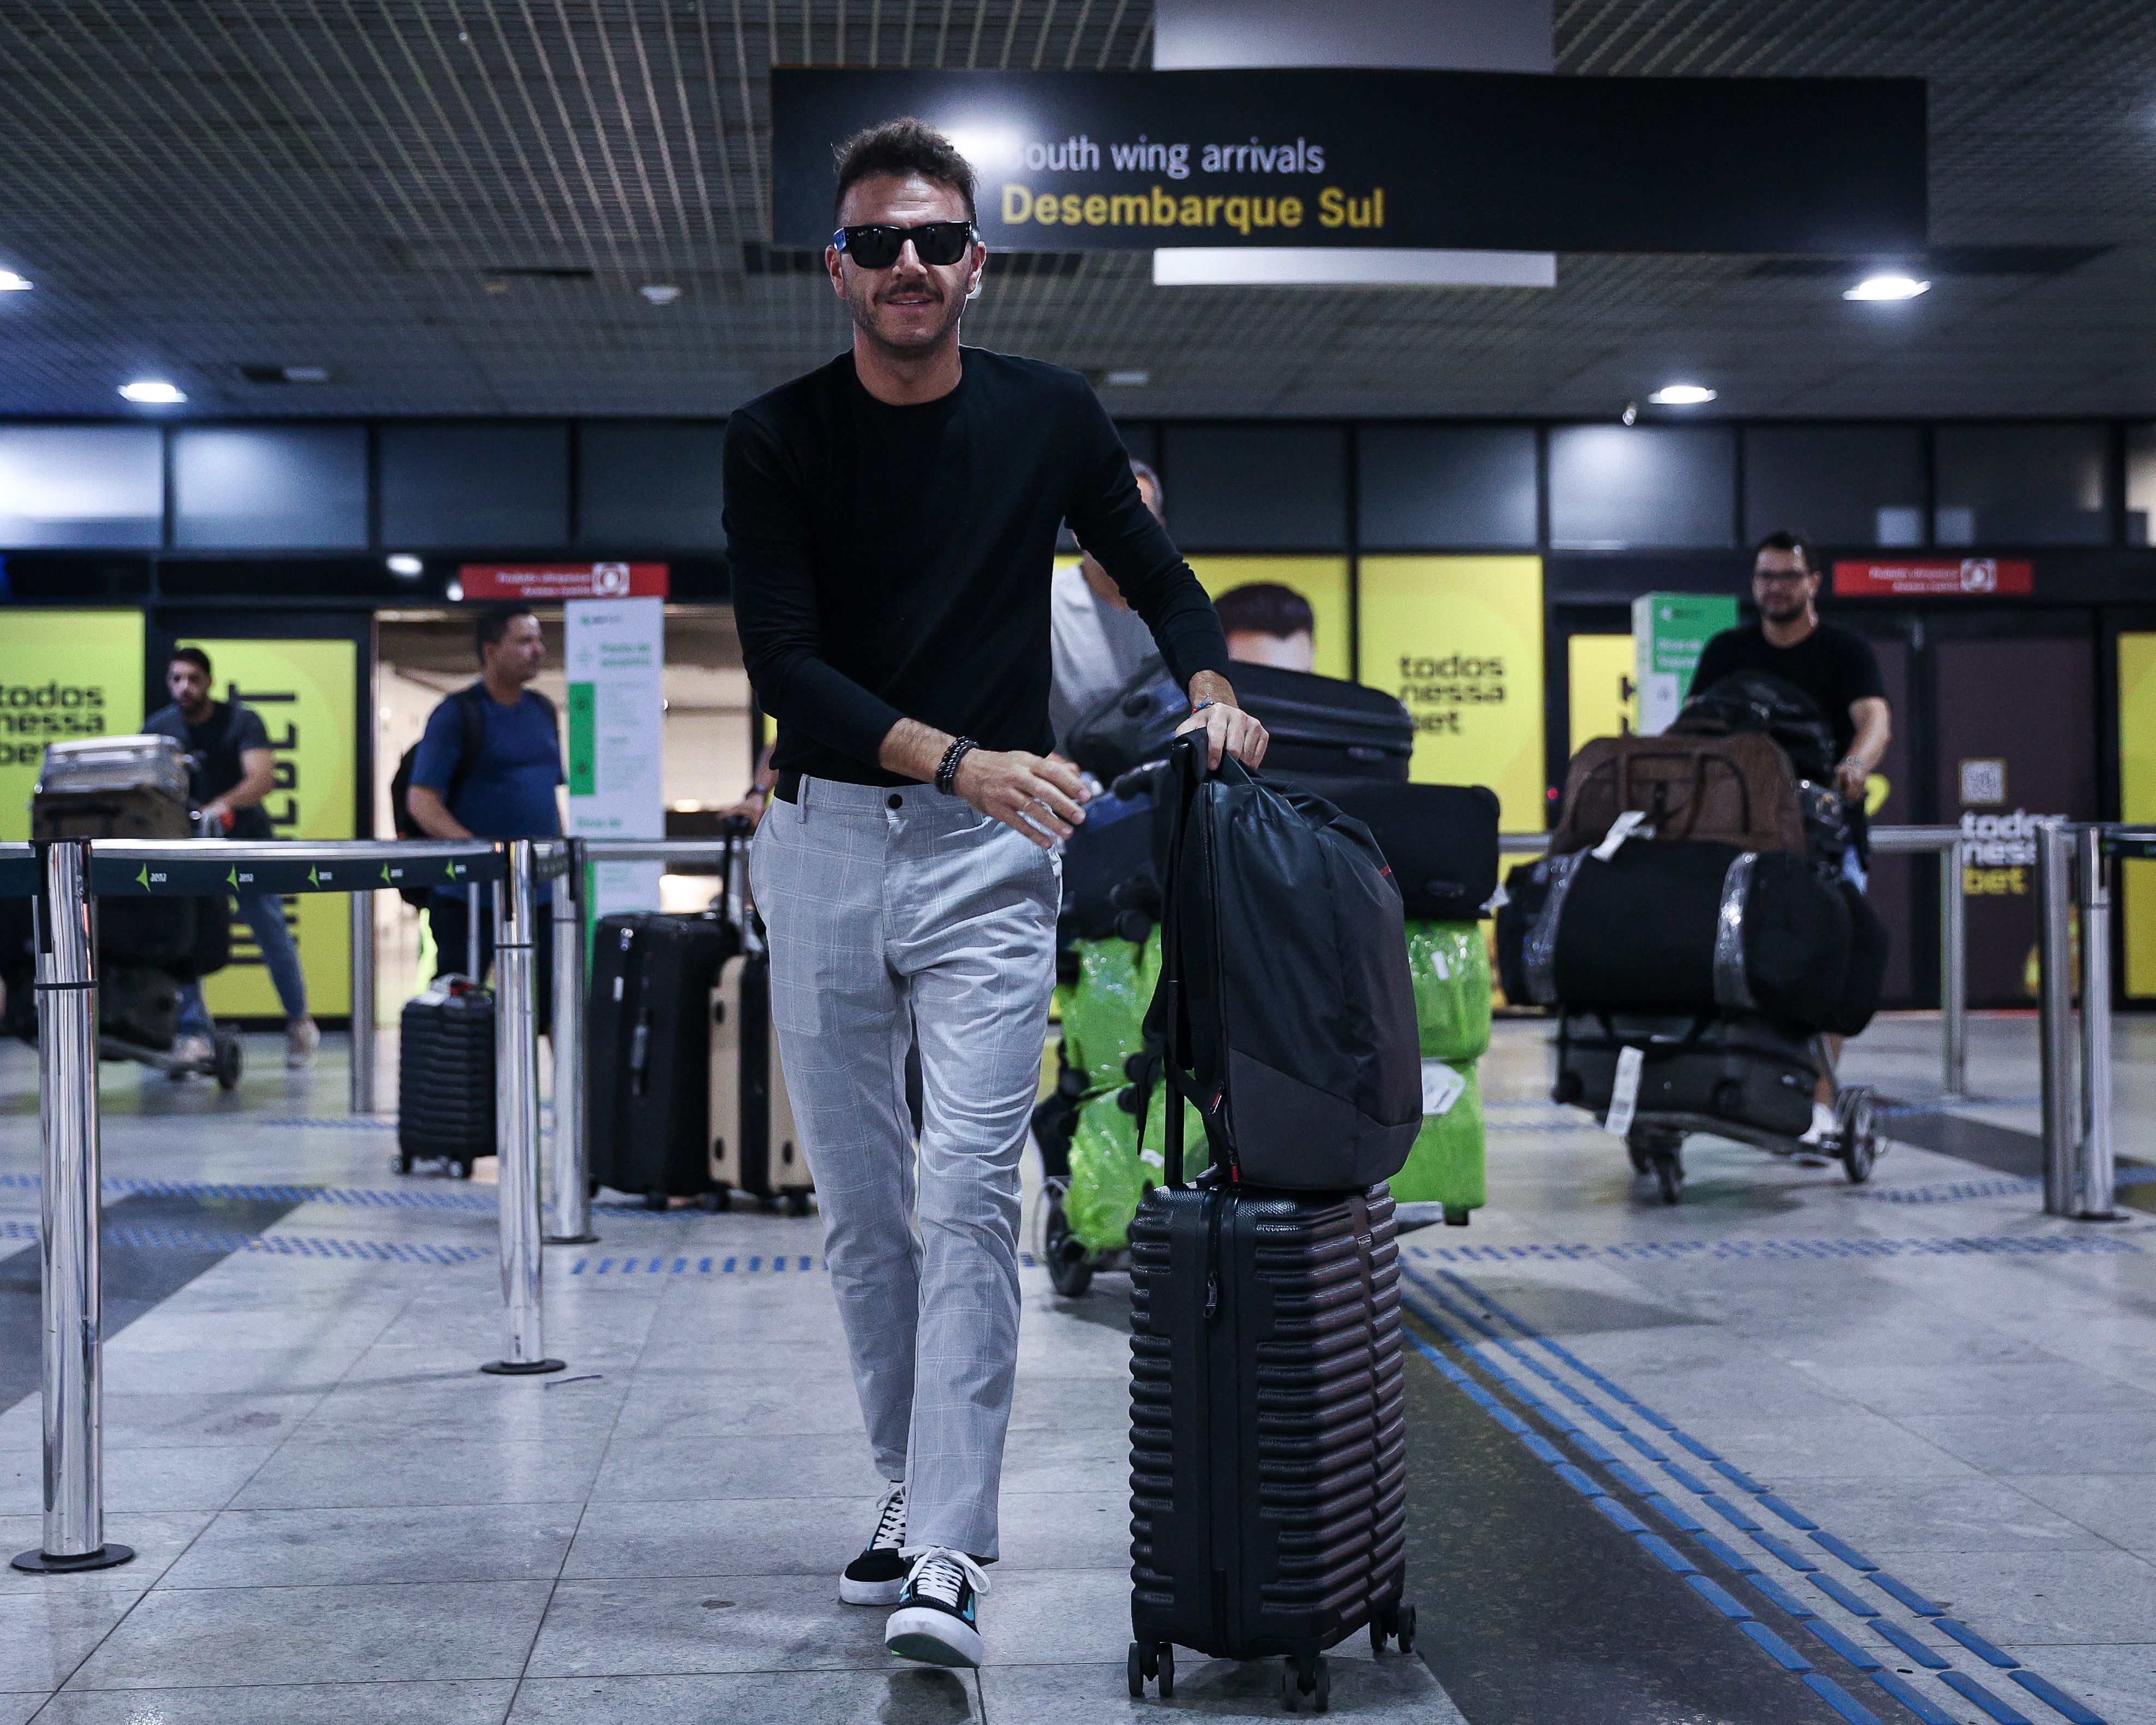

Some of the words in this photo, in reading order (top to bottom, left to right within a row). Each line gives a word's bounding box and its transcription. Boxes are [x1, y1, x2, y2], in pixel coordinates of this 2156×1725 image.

[1024, 135, 1100, 171] outh
[1110, 134, 1191, 180] wing
[1201, 136, 1326, 174] arrivals
[1002, 185, 1304, 235] Desembarque
[1318, 186, 1385, 228] Sul
[1398, 653, 1505, 678] todos
[1398, 684, 1506, 703] nessa
[1962, 864, 2027, 895] bet
